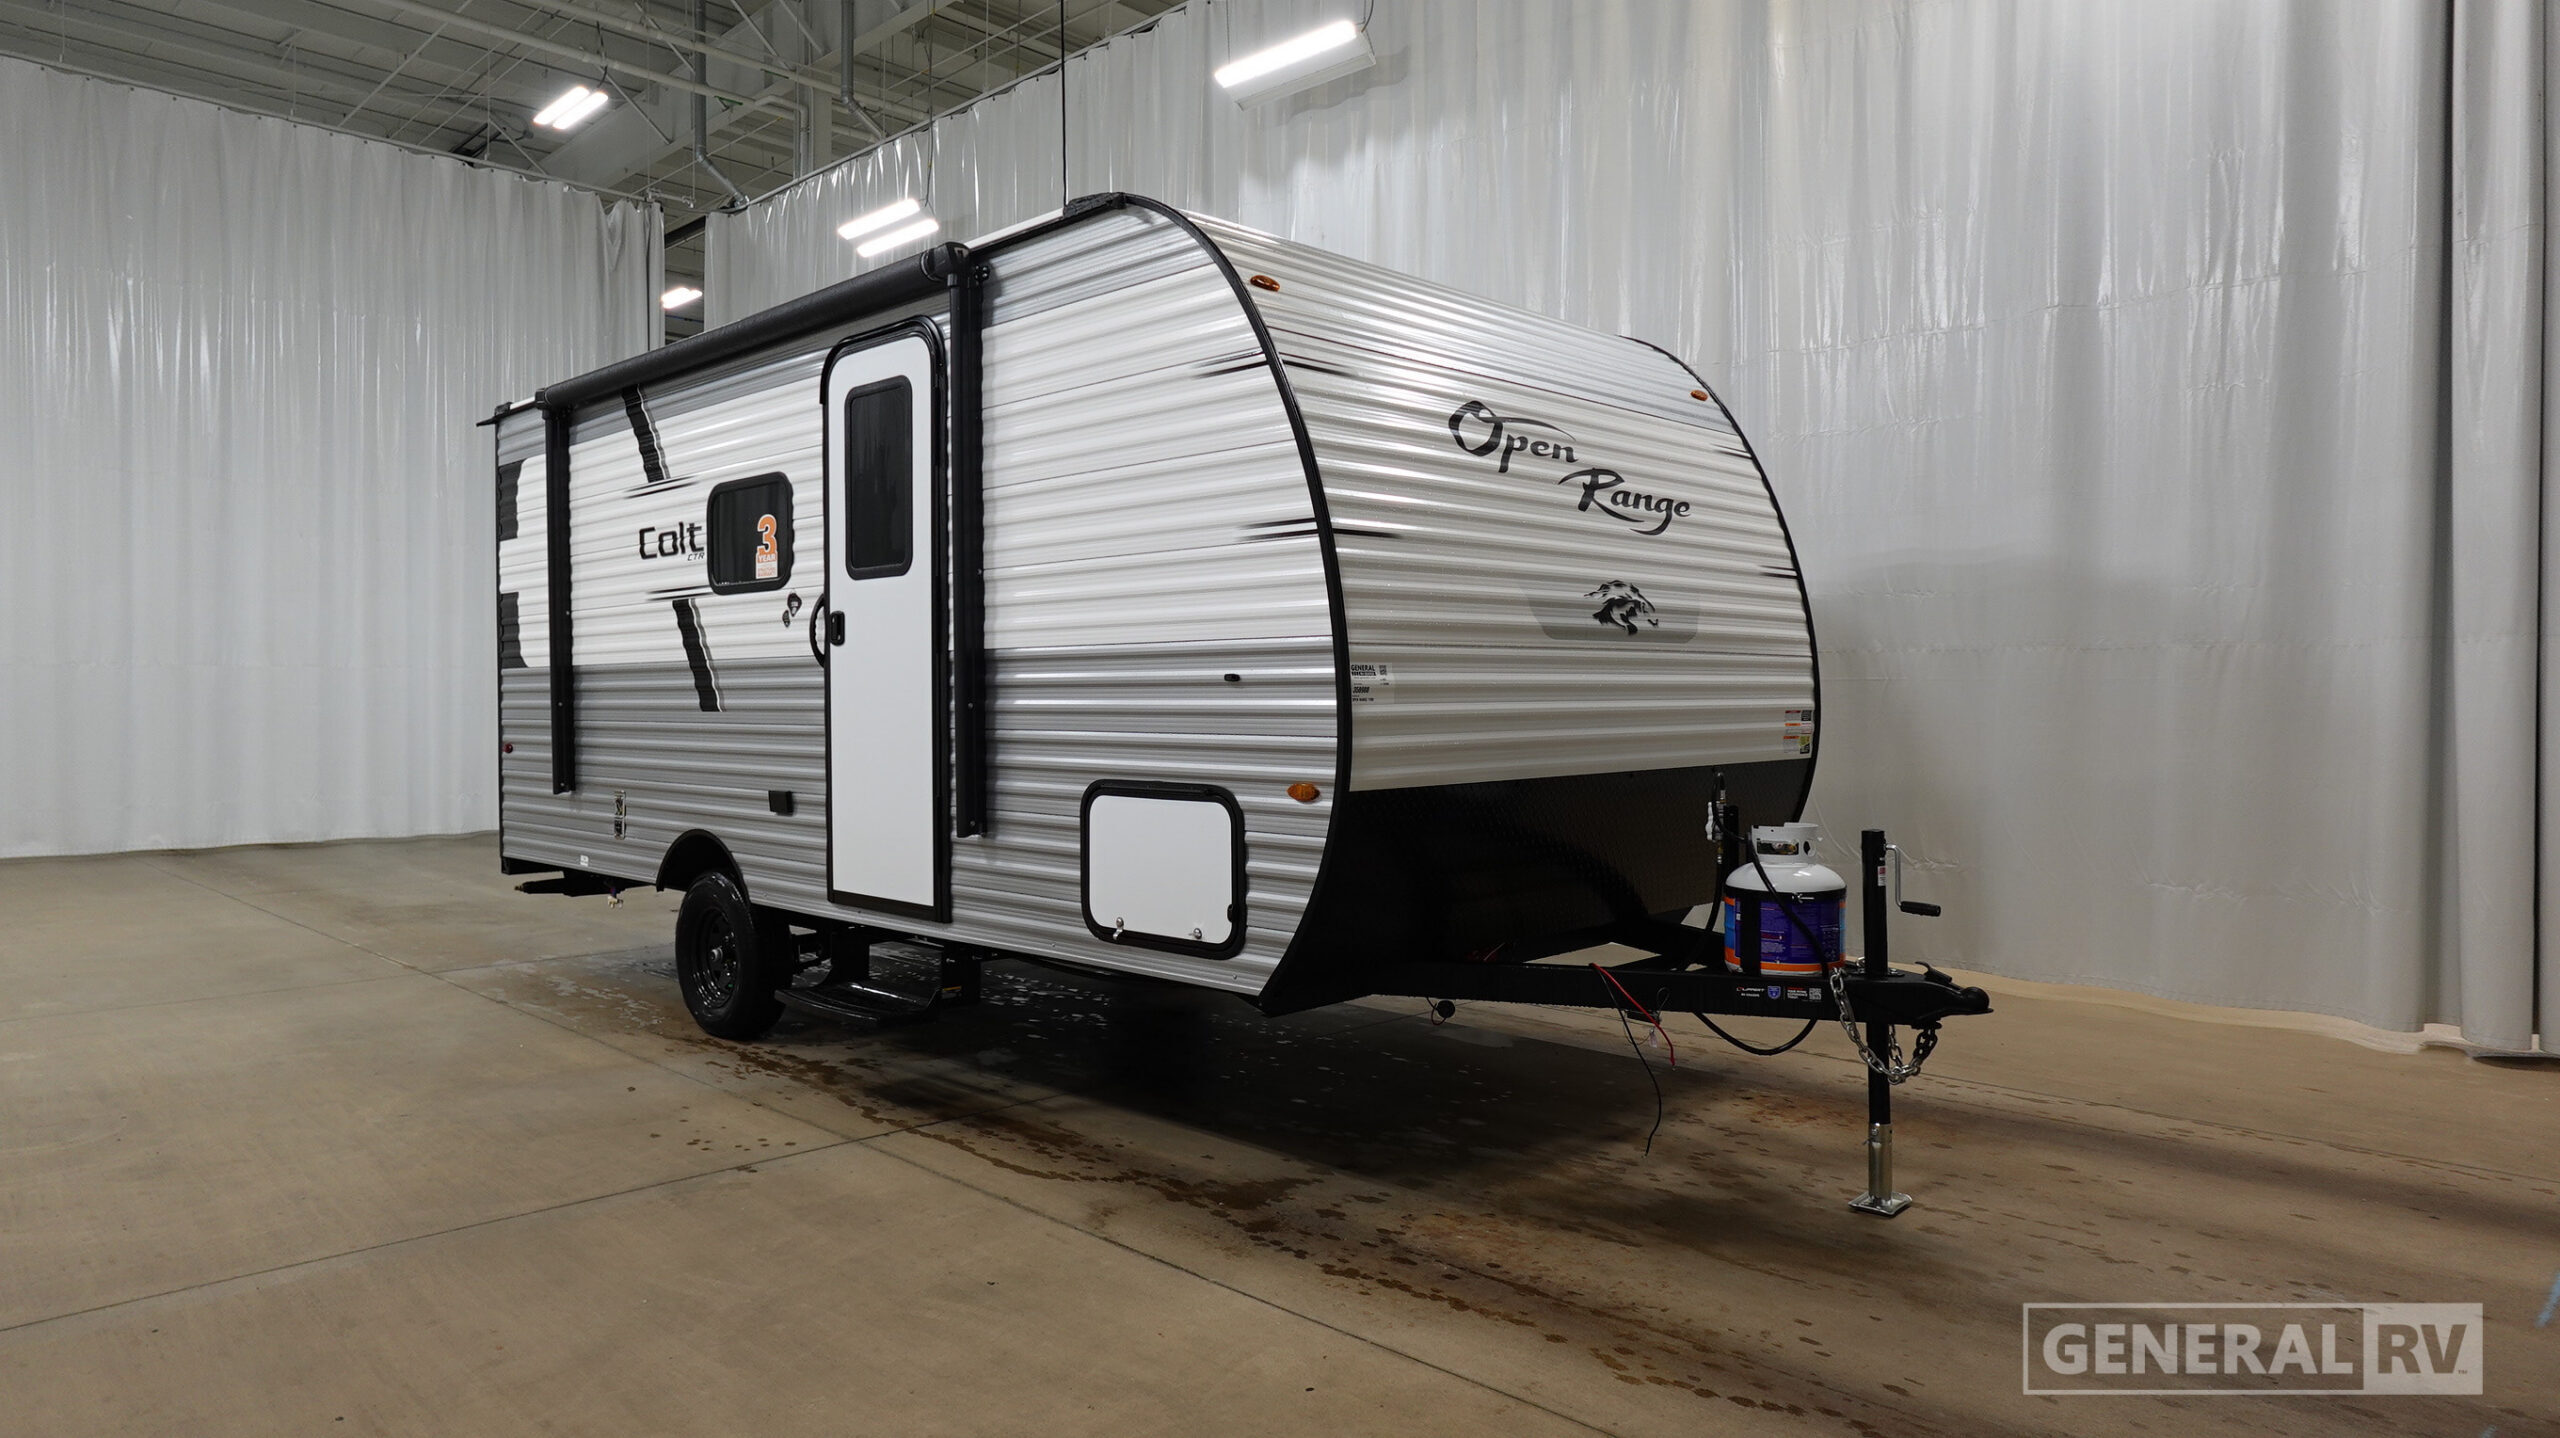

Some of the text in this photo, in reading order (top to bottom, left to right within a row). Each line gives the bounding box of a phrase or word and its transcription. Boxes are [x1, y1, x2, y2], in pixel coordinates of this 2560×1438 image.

[1448, 400, 1579, 473] Open
[1558, 467, 1691, 536] Range
[639, 521, 705, 560] Colt
[757, 514, 777, 555] 3
[687, 552, 705, 561] CTR
[758, 553, 777, 562] YEAR
[1350, 664, 1376, 672] GENERAL
